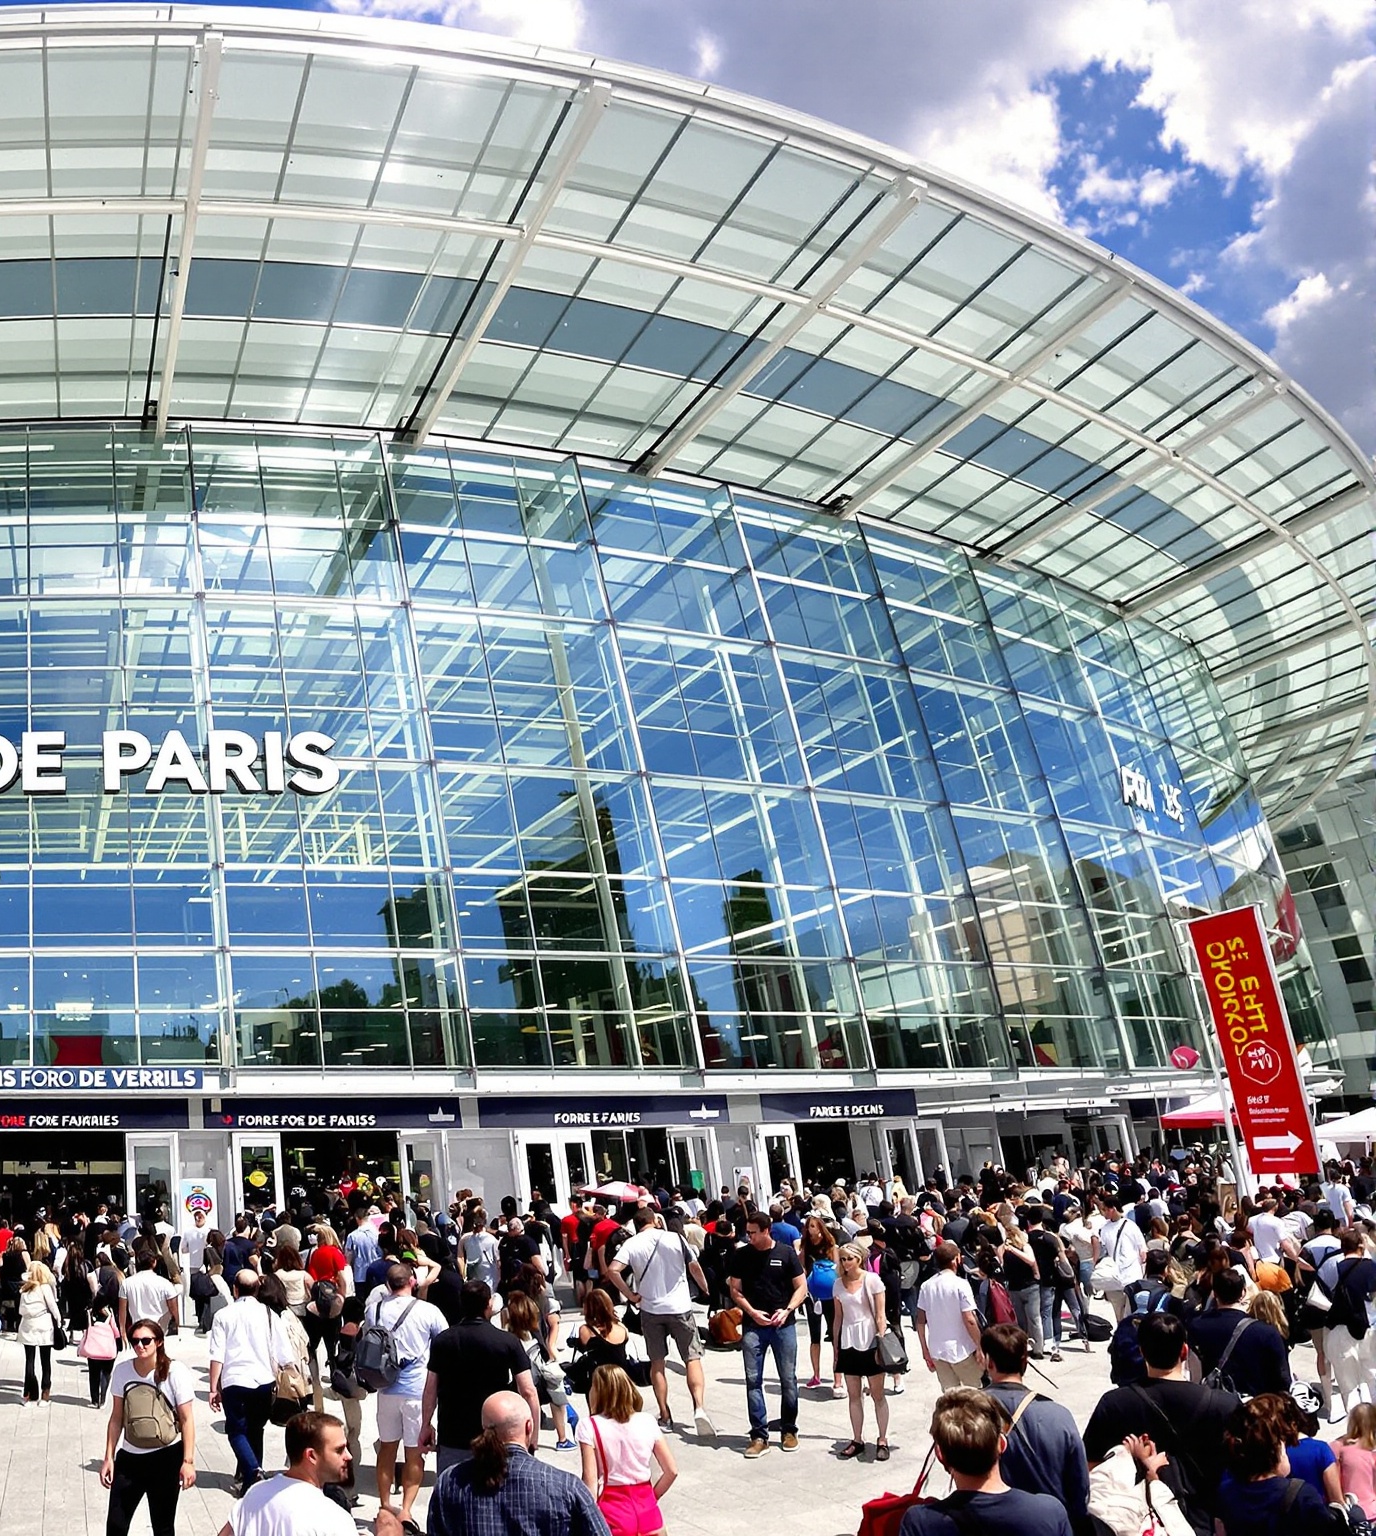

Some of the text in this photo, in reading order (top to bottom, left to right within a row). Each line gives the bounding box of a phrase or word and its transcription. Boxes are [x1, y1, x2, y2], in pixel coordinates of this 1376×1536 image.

[103, 730, 341, 795] PARIS
[21, 1070, 75, 1088] FORO
[79, 1070, 107, 1088] DE
[308, 1115, 326, 1126] DE
